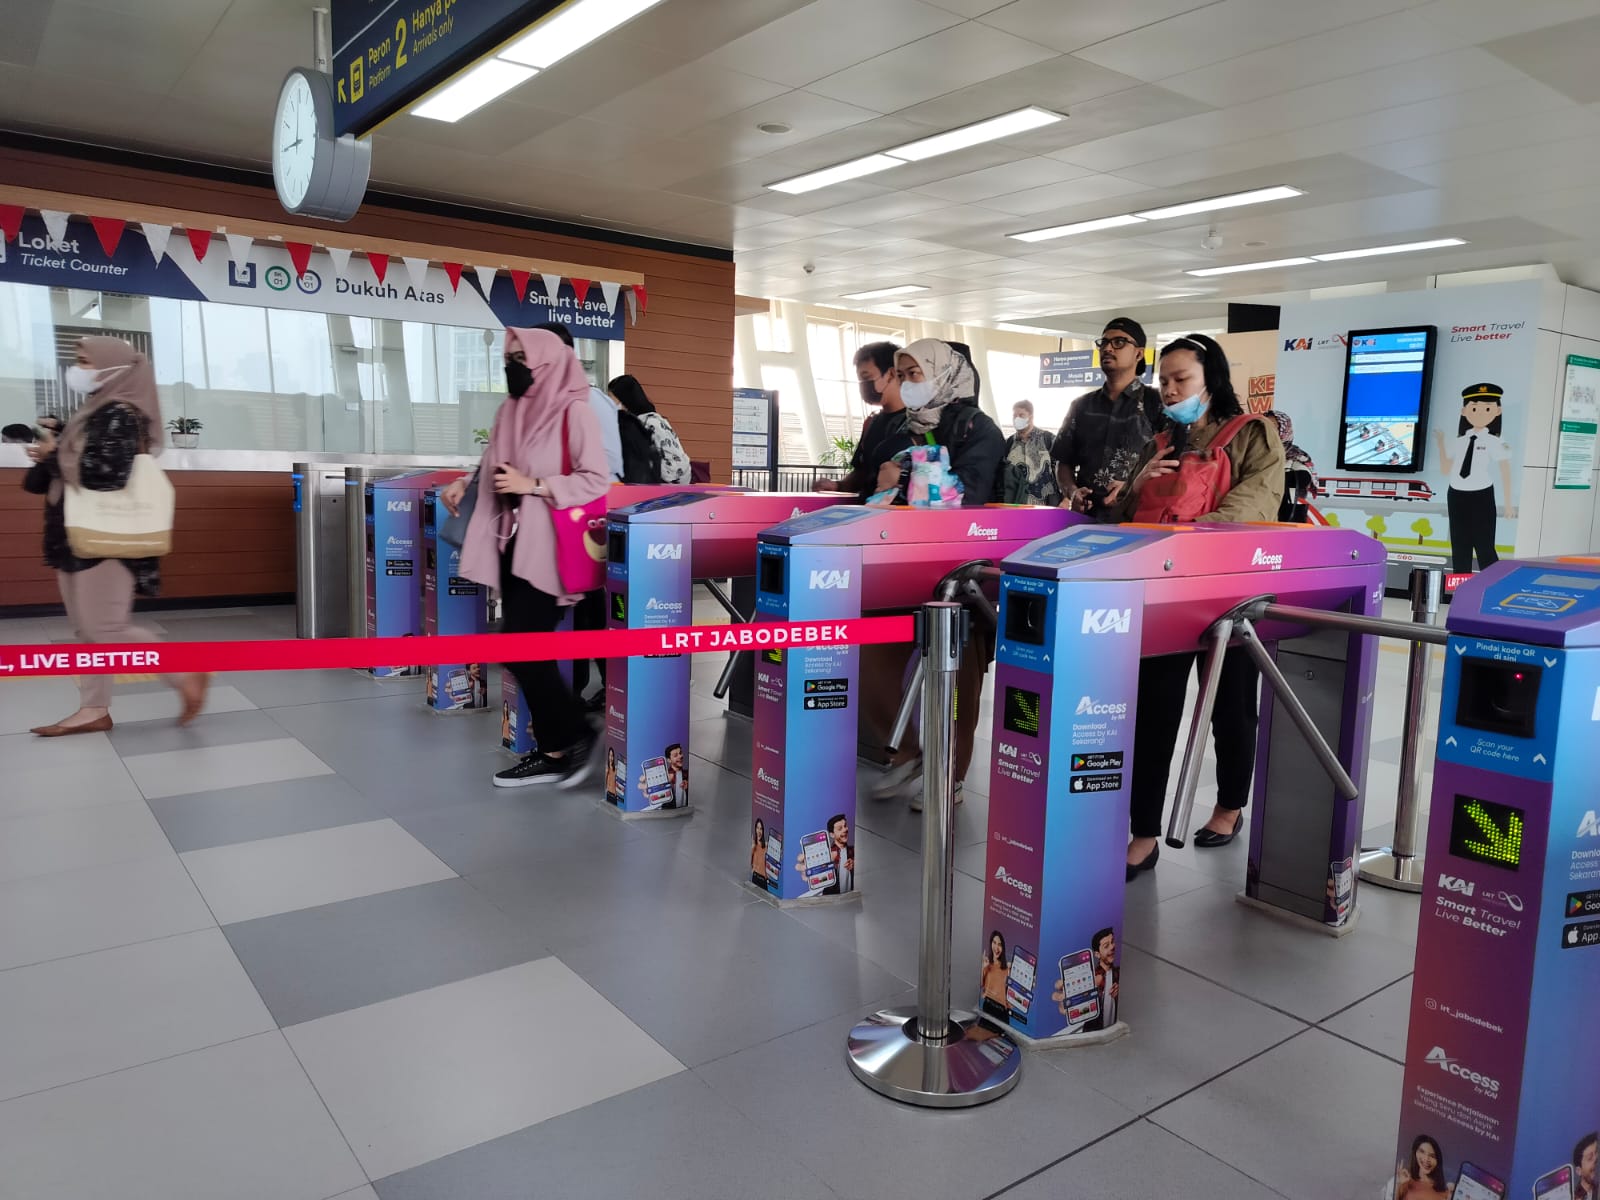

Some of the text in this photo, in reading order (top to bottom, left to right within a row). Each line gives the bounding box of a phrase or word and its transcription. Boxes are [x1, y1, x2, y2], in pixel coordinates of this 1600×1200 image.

[412, 0, 442, 35] Hanya
[395, 18, 408, 70] 2
[412, 14, 454, 57] Arrivals only
[368, 37, 391, 69] Peron
[368, 65, 392, 91] Platform
[18, 232, 80, 254] Loket
[21, 253, 129, 276] Ticket Counter
[335, 277, 398, 300] Dukuh
[548, 308, 616, 329] live better
[1451, 321, 1526, 334] Smart Travel
[1450, 333, 1513, 343] Live better
[646, 543, 683, 560] KAI
[809, 569, 850, 590] KAI
[1081, 608, 1132, 635] KAI
[661, 625, 849, 649] LRT JABODEBEK
[1476, 641, 1536, 657] Pindai kode QR
[1493, 653, 1517, 662] di sini
[19, 653, 70, 669] LIVE
[76, 651, 160, 668] BETTER
[1075, 695, 1127, 715] Access
[1072, 722, 1107, 731] Download
[998, 742, 1018, 758] KAI
[1470, 745, 1520, 762] QR code here
[1476, 738, 1515, 752] Scan your
[997, 758, 1019, 771] Smart
[1086, 758, 1122, 769] Google Play
[1086, 781, 1120, 791] App Store
[994, 865, 1033, 894] Access
[1437, 873, 1476, 897] KAI
[1434, 907, 1508, 937] Live Better
[1435, 896, 1477, 916] Smart
[1480, 908, 1521, 930] Travel
[1423, 1046, 1500, 1092] Access
